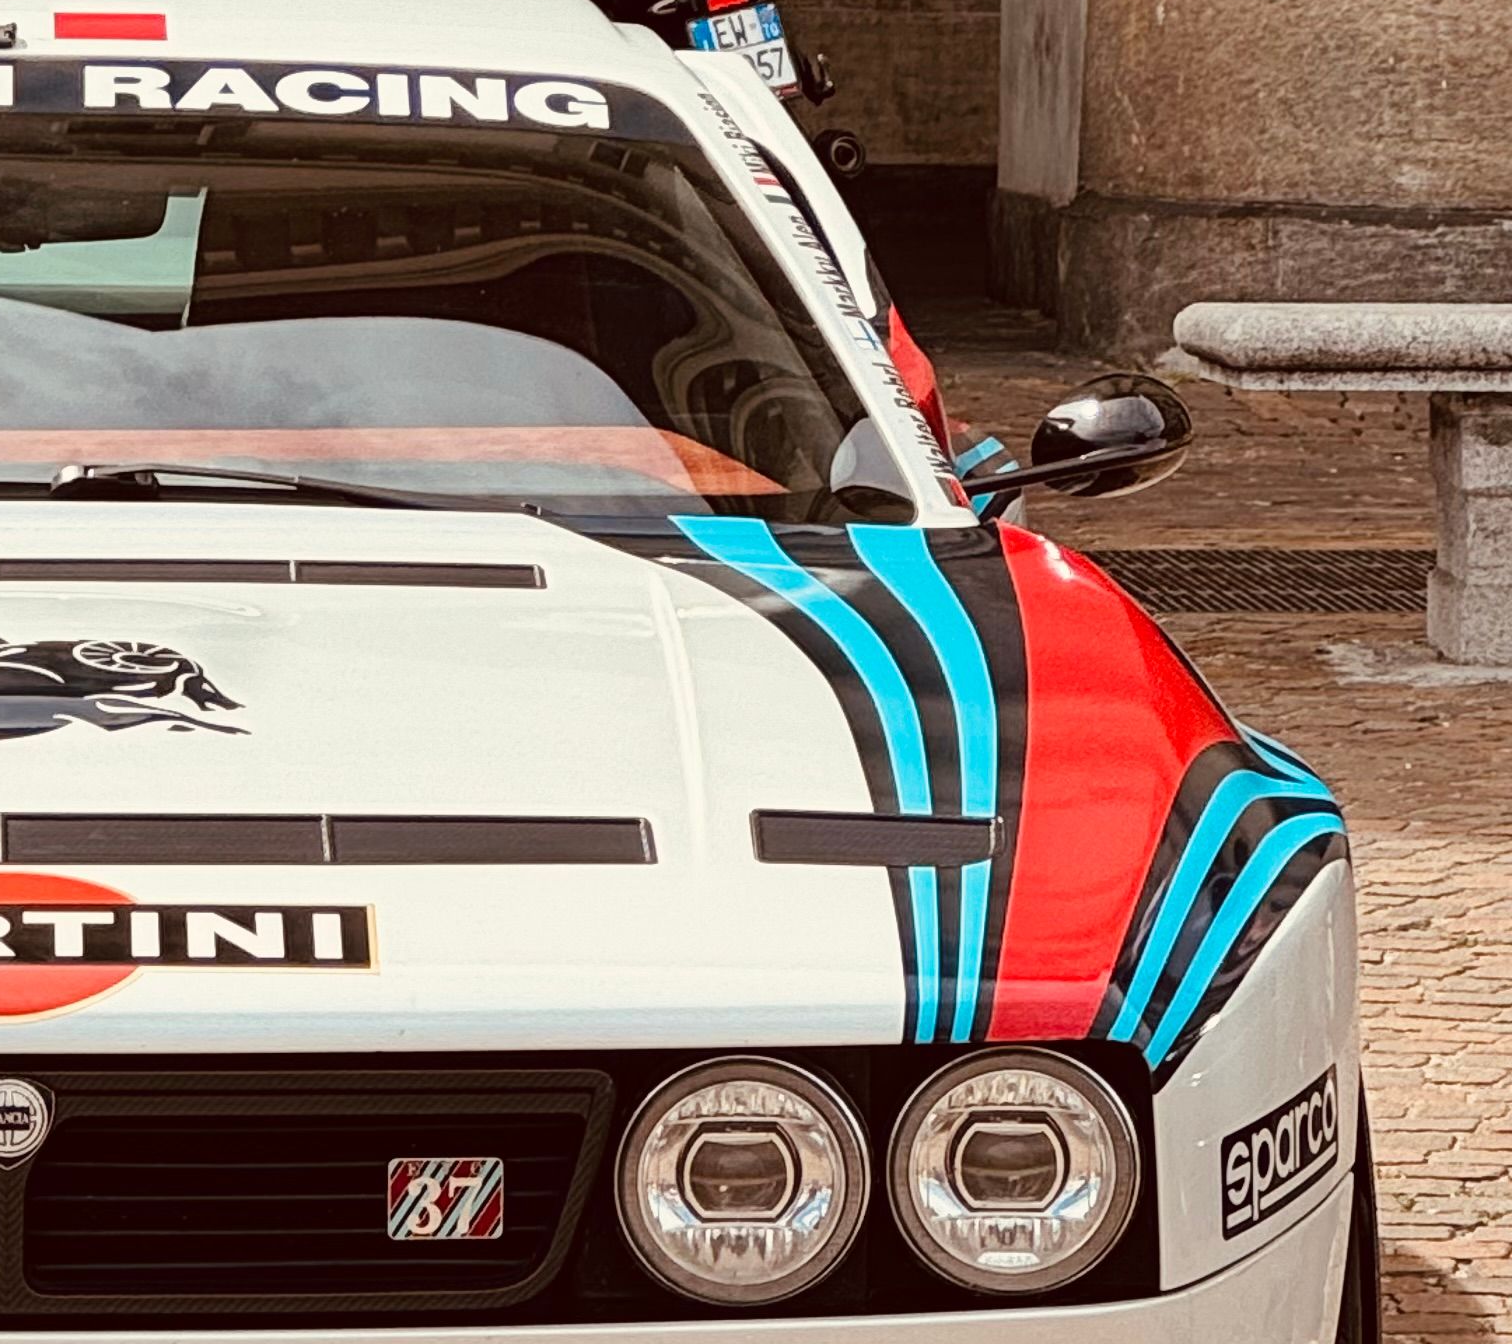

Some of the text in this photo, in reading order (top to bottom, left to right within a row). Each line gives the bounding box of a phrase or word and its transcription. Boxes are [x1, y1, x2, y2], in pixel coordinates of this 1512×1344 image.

[713, 14, 749, 50] EW
[83, 64, 610, 130] RACING
[1225, 1076, 1337, 1221] sparco
[407, 1175, 484, 1235] 37
